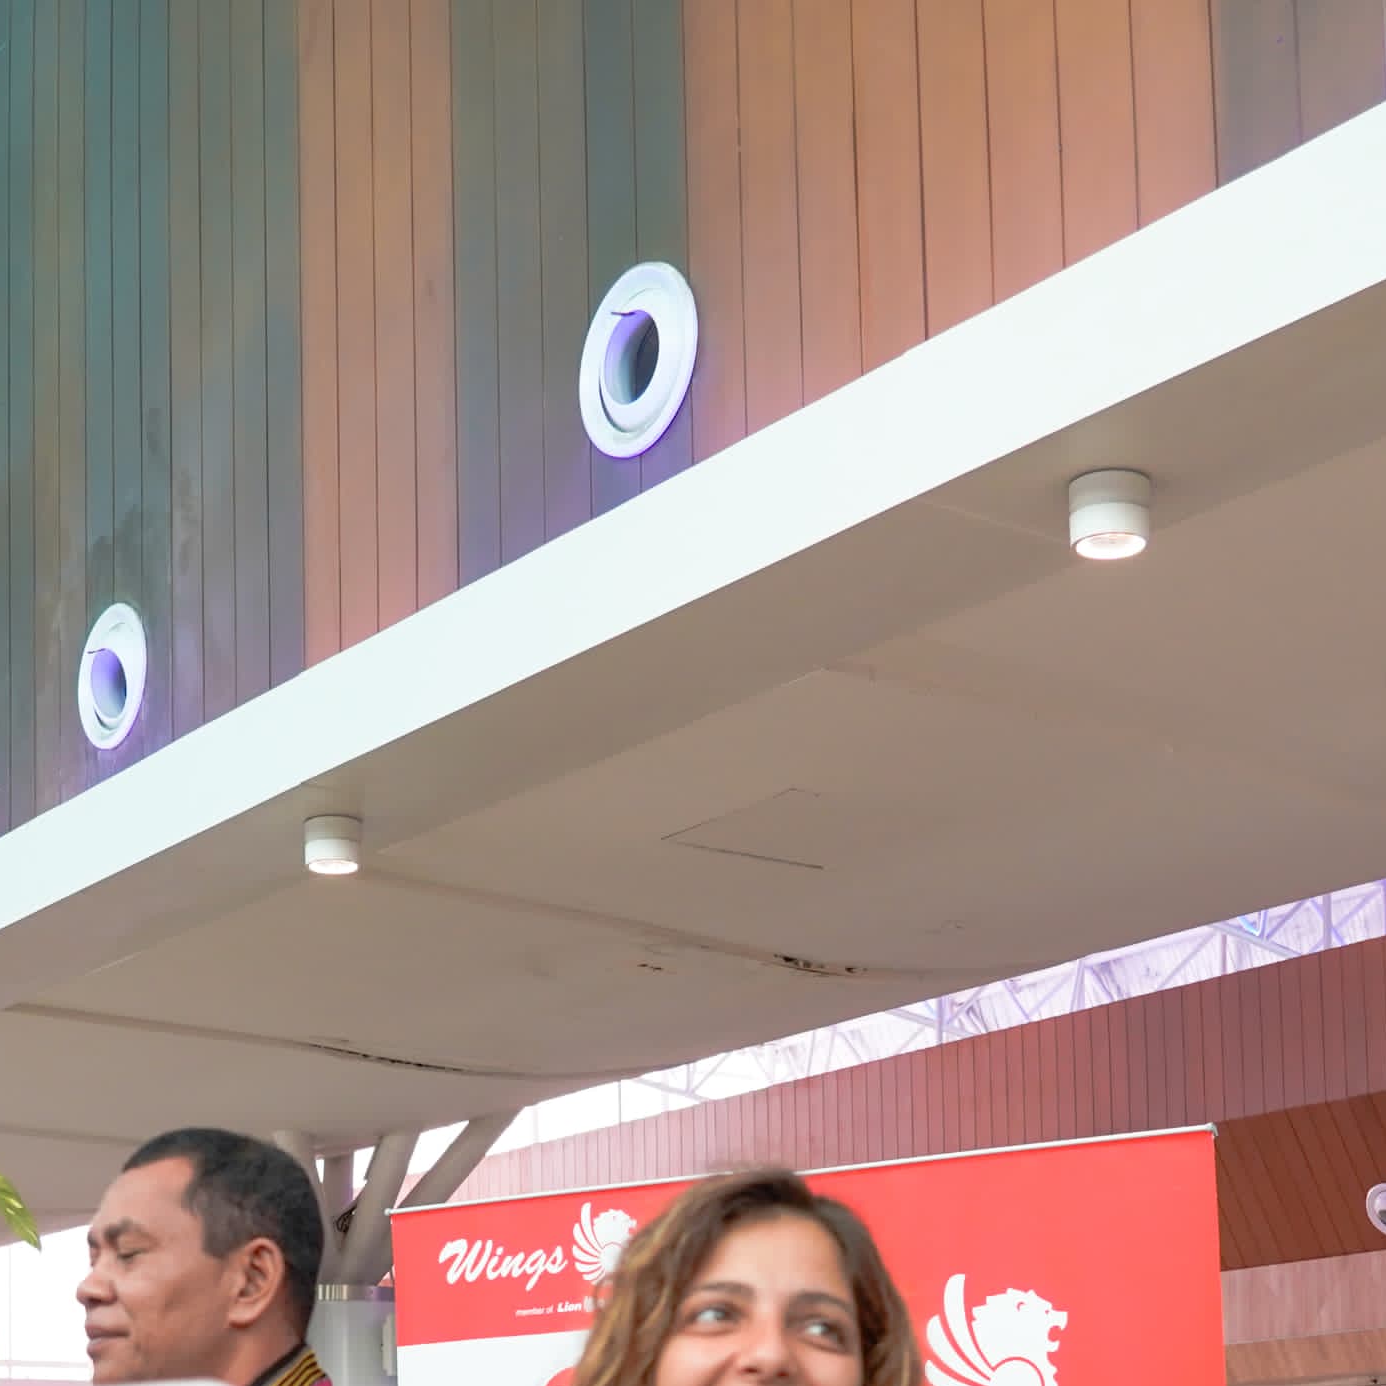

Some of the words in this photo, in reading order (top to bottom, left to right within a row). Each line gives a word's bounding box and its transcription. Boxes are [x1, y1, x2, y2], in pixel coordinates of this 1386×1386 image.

[438, 1238, 568, 1292] Wings
[515, 1306, 545, 1317] member
[557, 1301, 583, 1313] Lion
